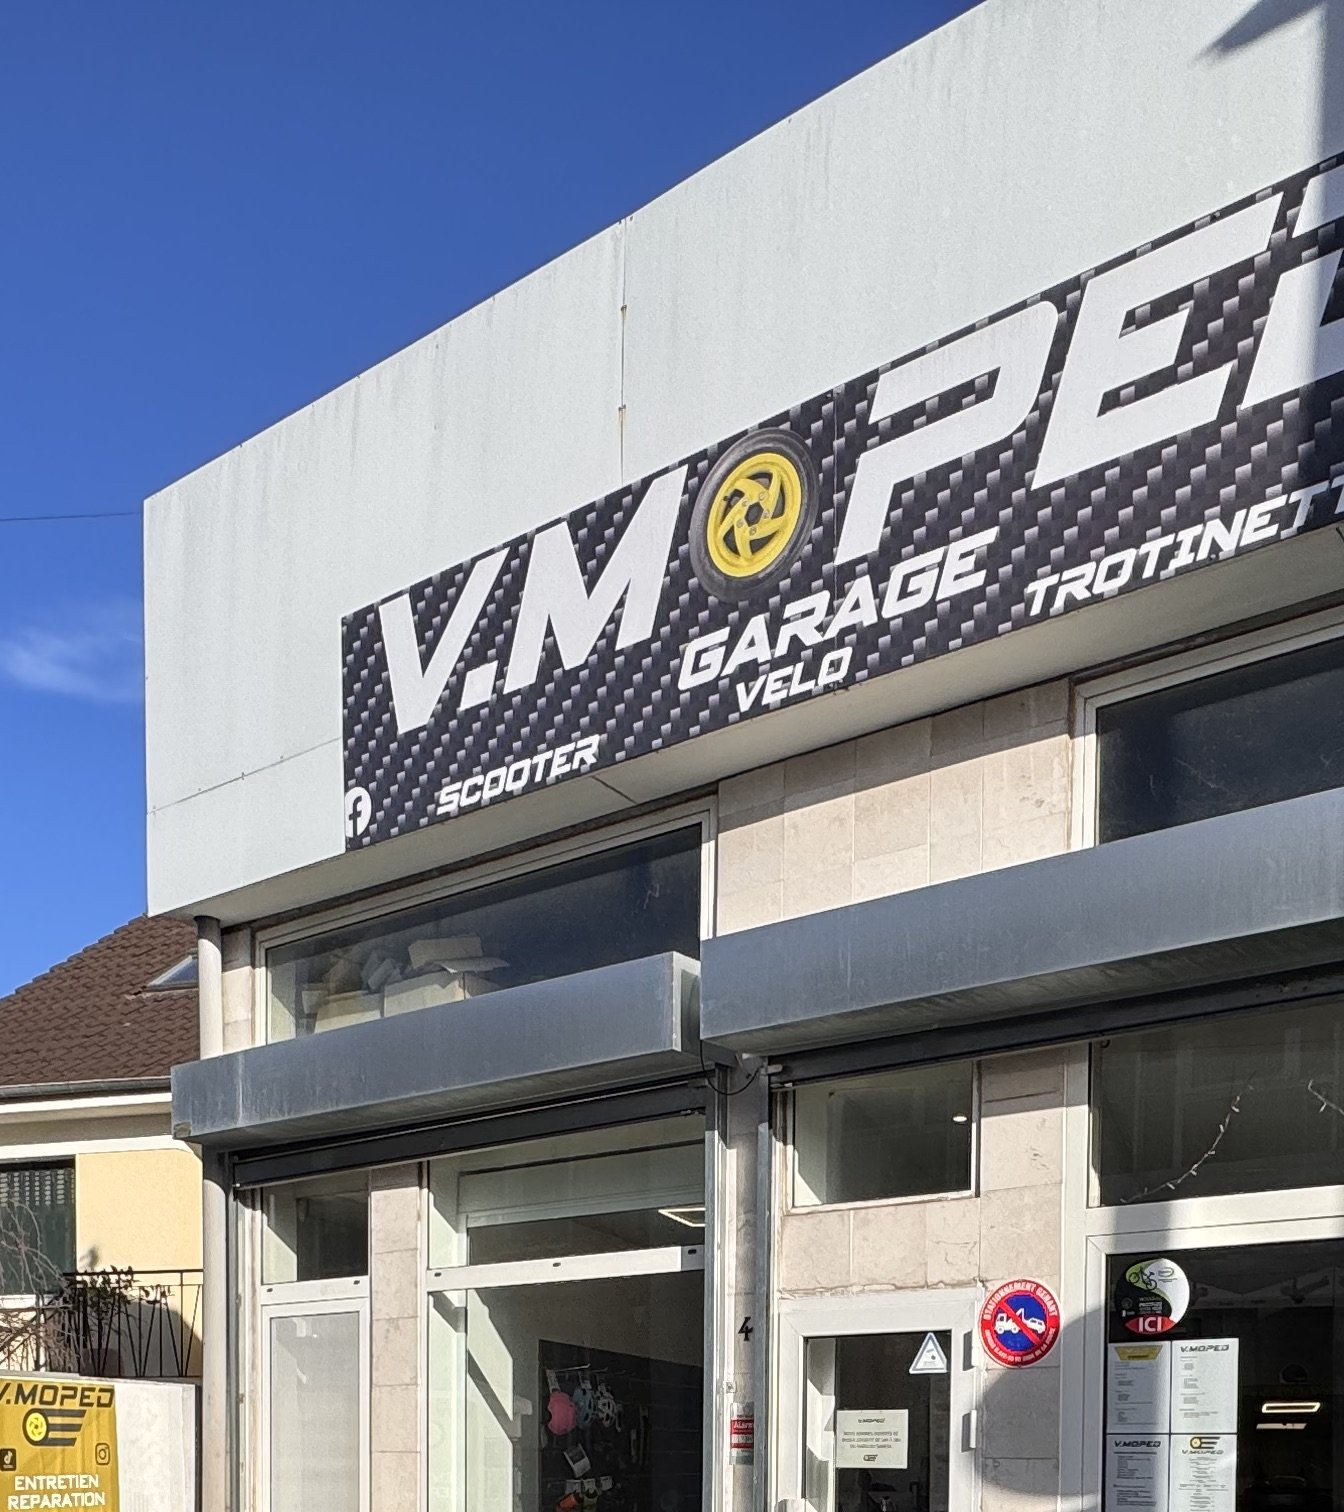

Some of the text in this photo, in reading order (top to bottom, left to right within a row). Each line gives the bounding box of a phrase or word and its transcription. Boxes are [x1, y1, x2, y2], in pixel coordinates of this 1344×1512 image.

[679, 528, 998, 691] GARAGE
[436, 734, 600, 816] SCOOTER
[736, 647, 852, 712] VELO
[738, 1317, 753, 1341] 4
[1138, 1316, 1163, 1332] ICI
[14, 1474, 99, 1491] ENTRETIEN
[7, 1492, 106, 1510] REPARATION
